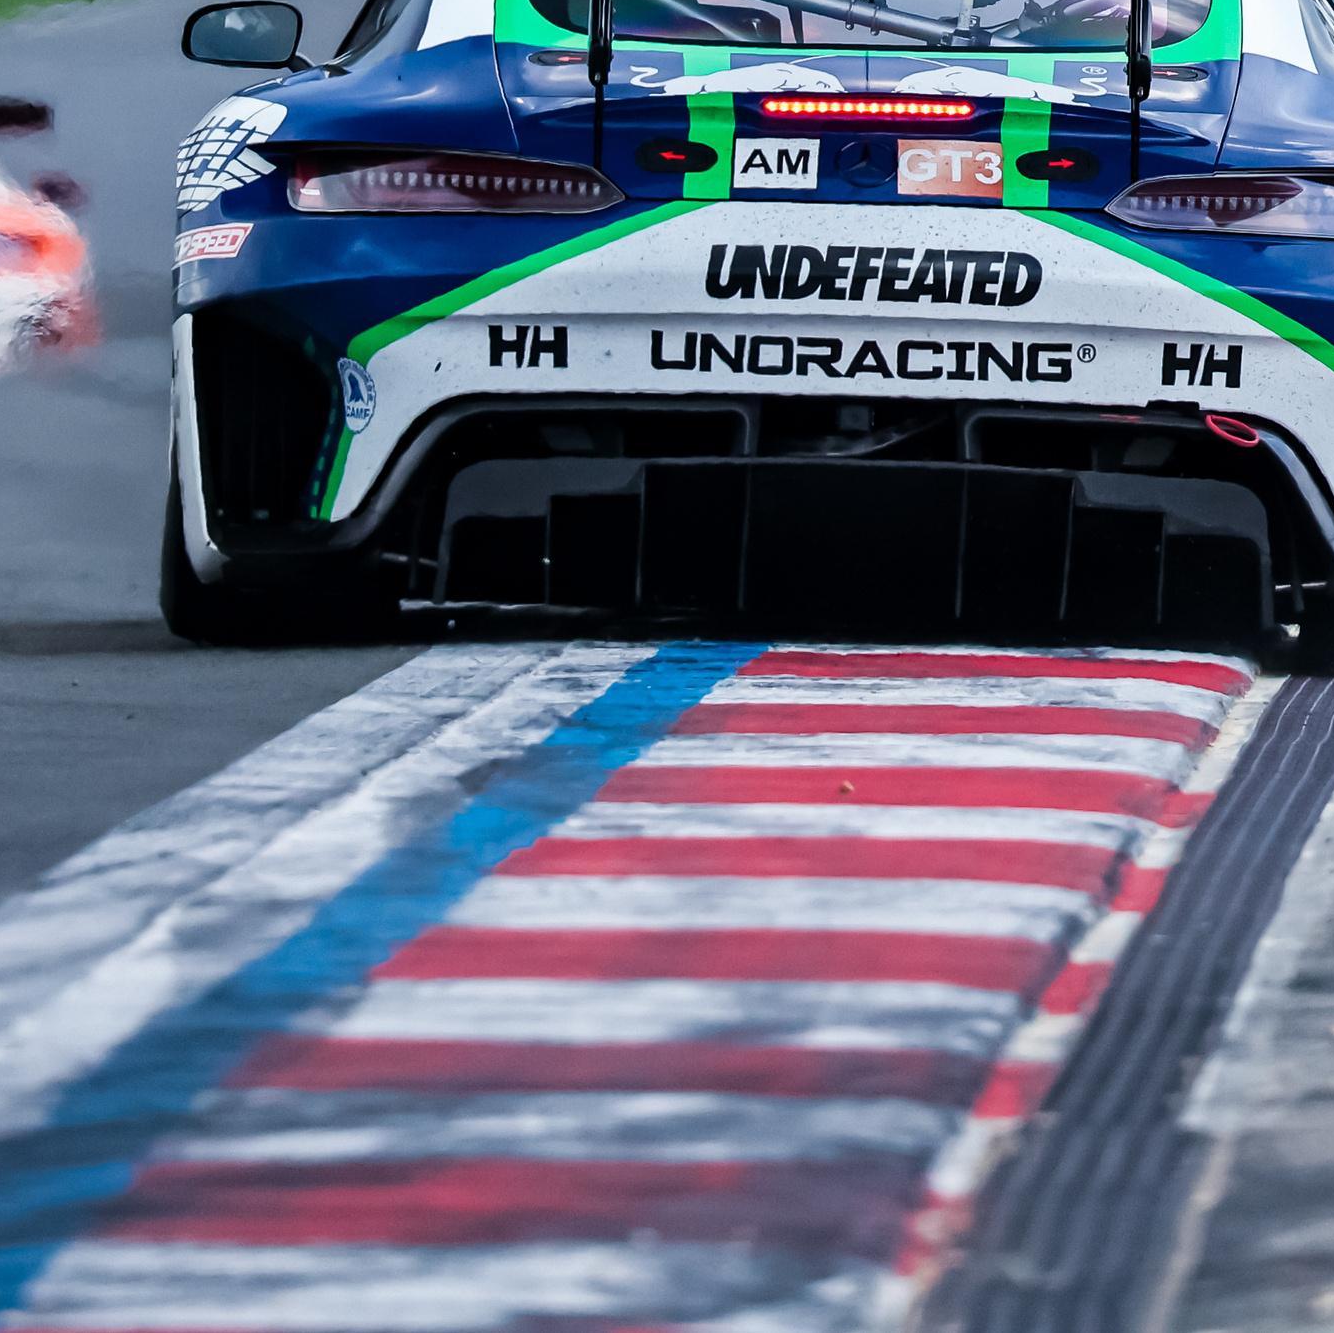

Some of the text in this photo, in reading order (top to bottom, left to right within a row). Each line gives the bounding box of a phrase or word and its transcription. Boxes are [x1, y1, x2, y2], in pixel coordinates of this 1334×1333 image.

[740, 149, 810, 176] AM
[898, 147, 1003, 184] GT3
[705, 244, 1043, 307] UNDEFEATED
